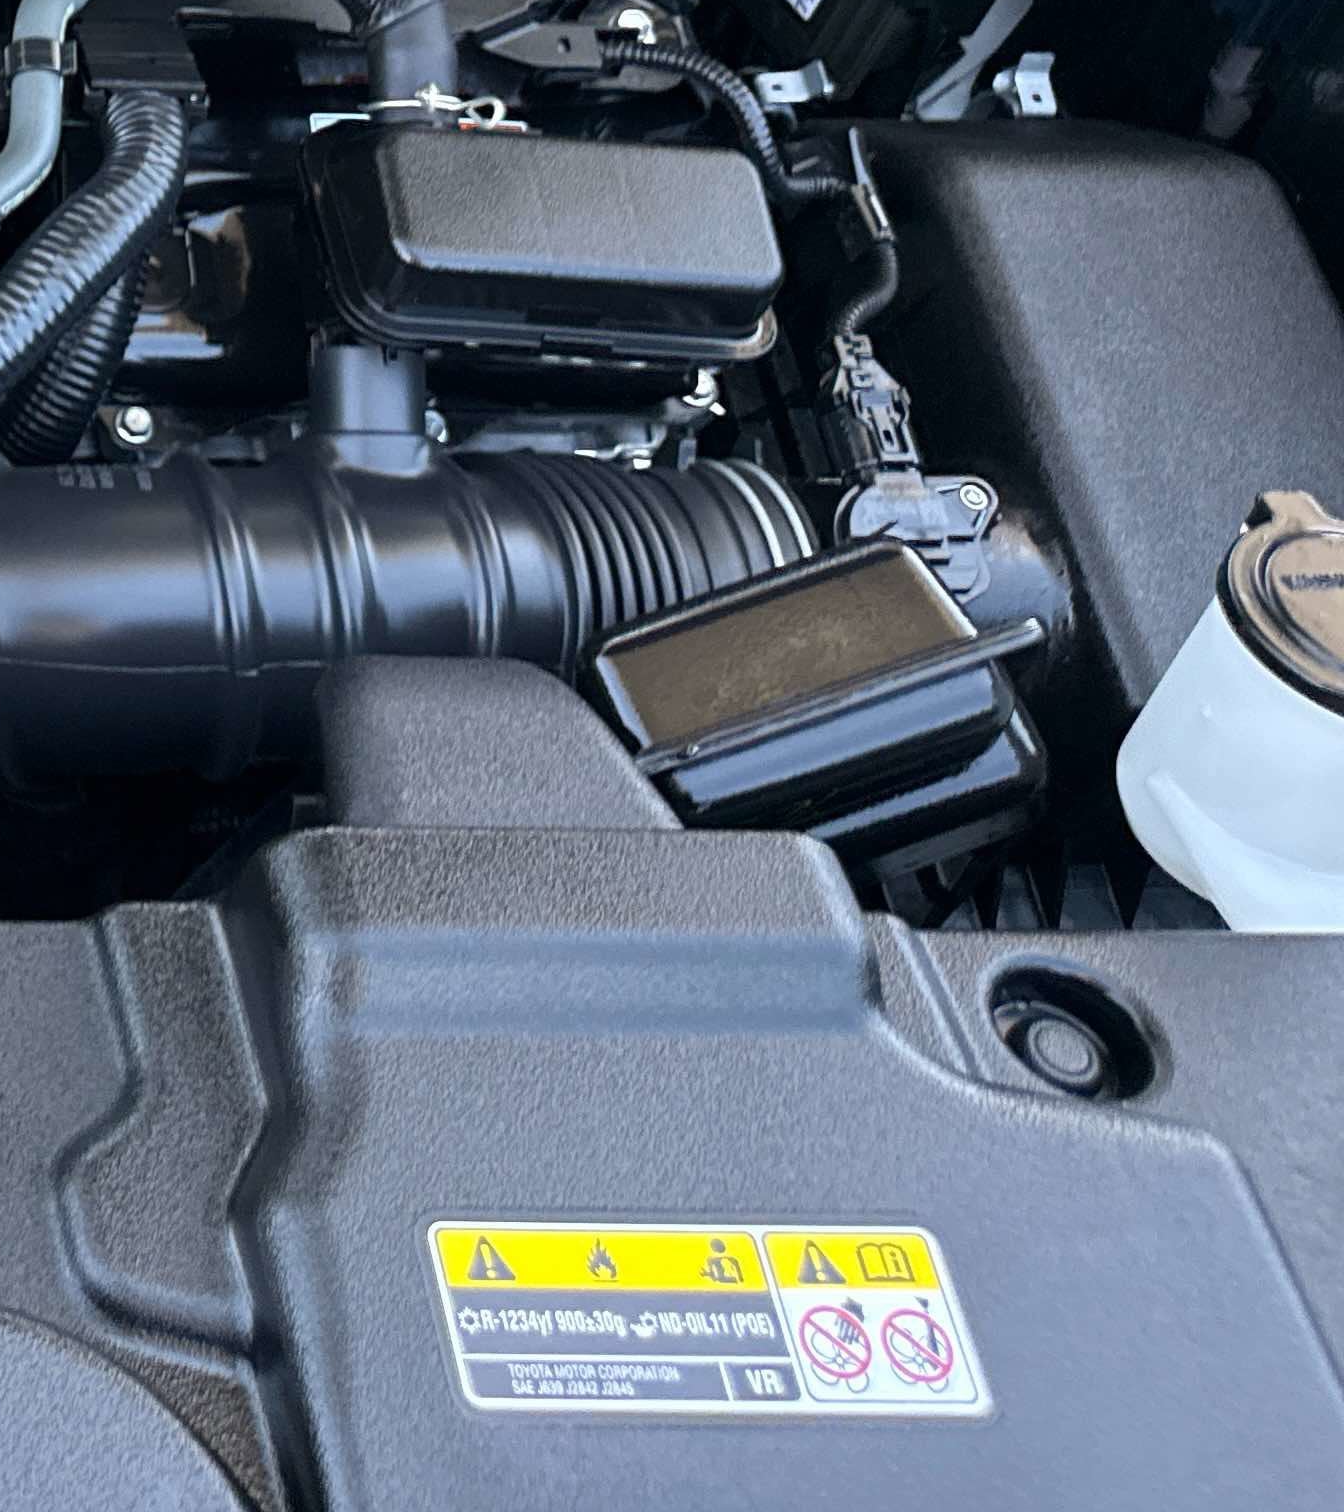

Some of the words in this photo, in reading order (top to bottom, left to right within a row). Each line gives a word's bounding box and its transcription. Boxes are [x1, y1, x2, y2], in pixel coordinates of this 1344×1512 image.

[480, 1309, 553, 1336] R-1234yf
[732, 1311, 776, 1339] (POE)
[508, 1363, 553, 1379] TOYOTA
[555, 1364, 597, 1380] MOTOR
[597, 1364, 680, 1381] CORPORATION
[744, 1369, 783, 1395] VR
[511, 1380, 534, 1395] SAE
